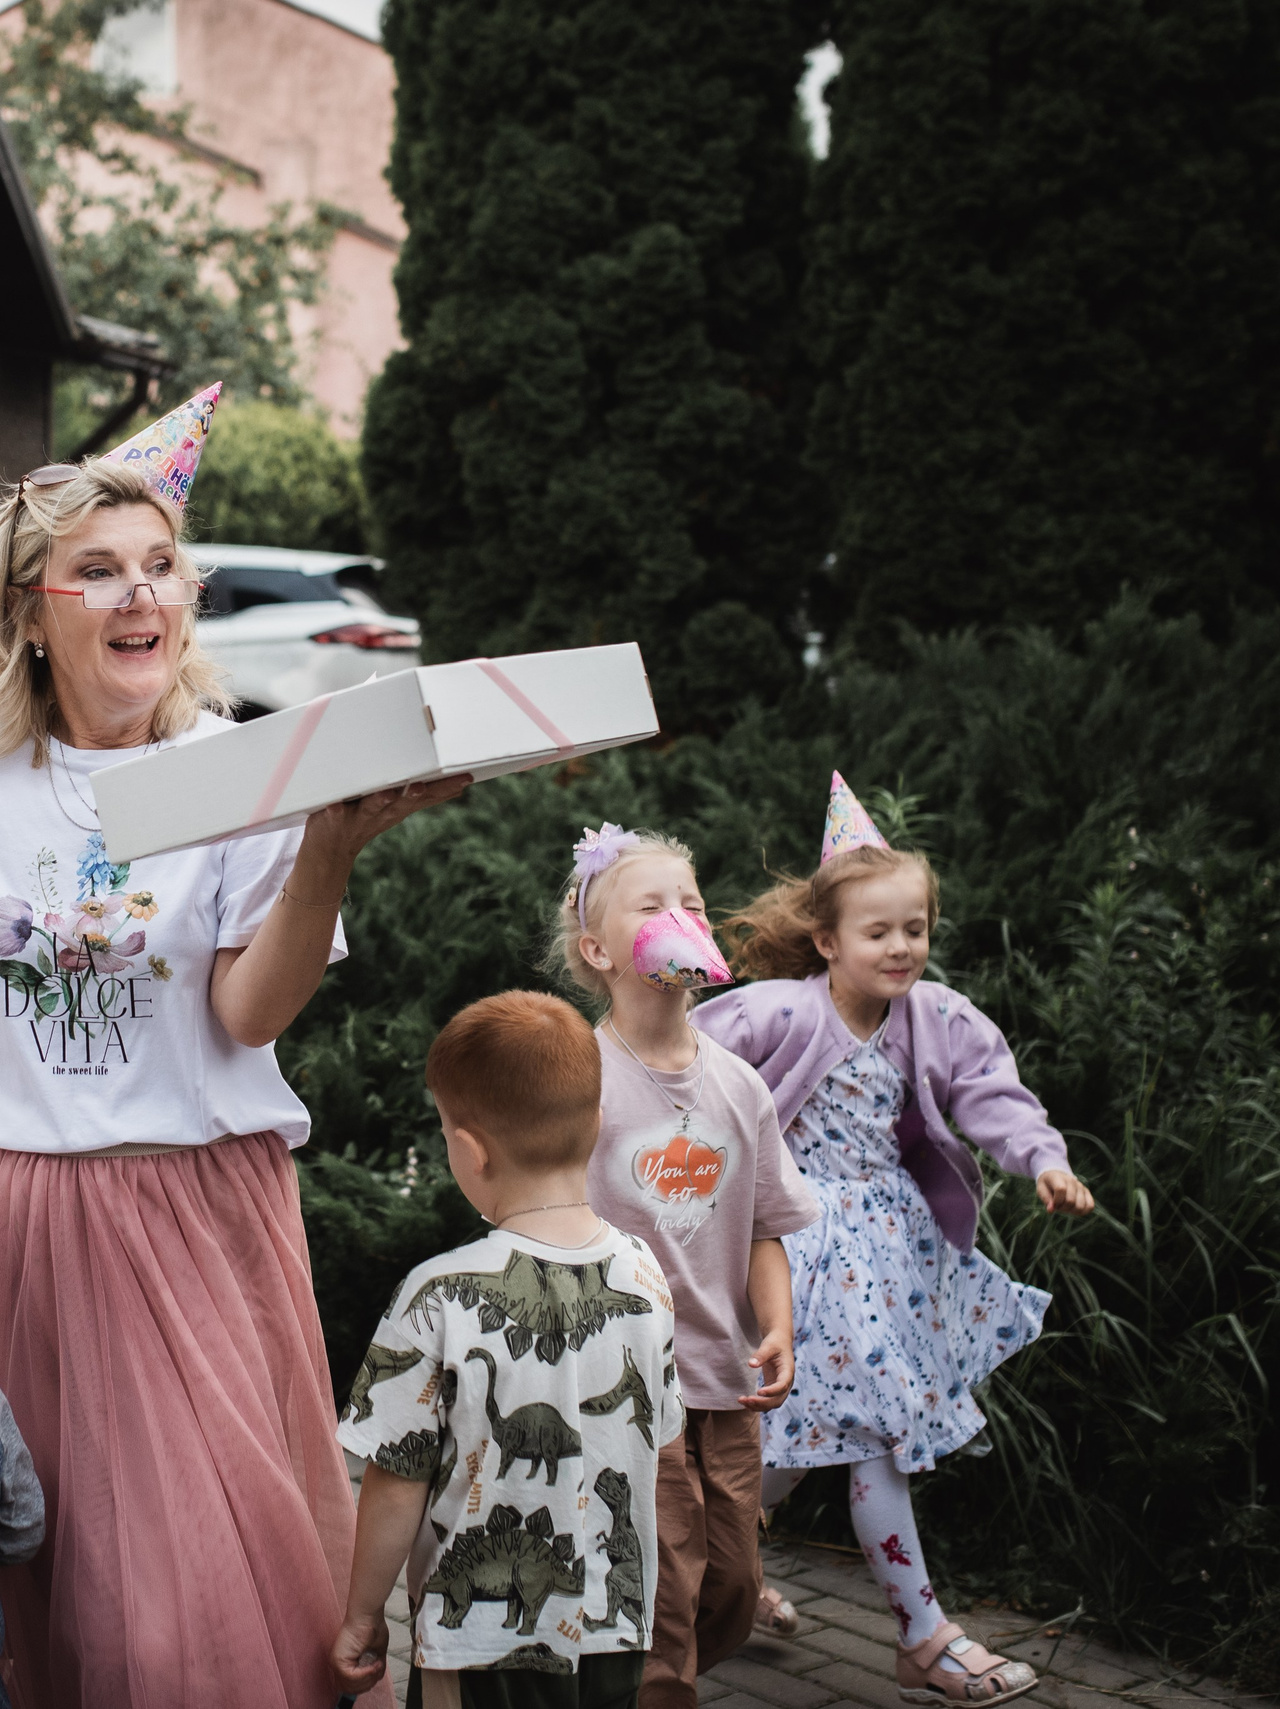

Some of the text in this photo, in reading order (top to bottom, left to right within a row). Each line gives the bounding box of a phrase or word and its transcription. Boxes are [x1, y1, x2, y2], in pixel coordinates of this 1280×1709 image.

[155, 456, 193, 498] Днё
[52, 932, 100, 976] LA
[3, 974, 153, 1019] DOLCE
[27, 1020, 130, 1063] VITA
[52, 1065, 109, 1076] the sweet life
[642, 1154, 720, 1200] You are
[667, 1186, 698, 1206] so
[654, 1200, 708, 1247] lovely
